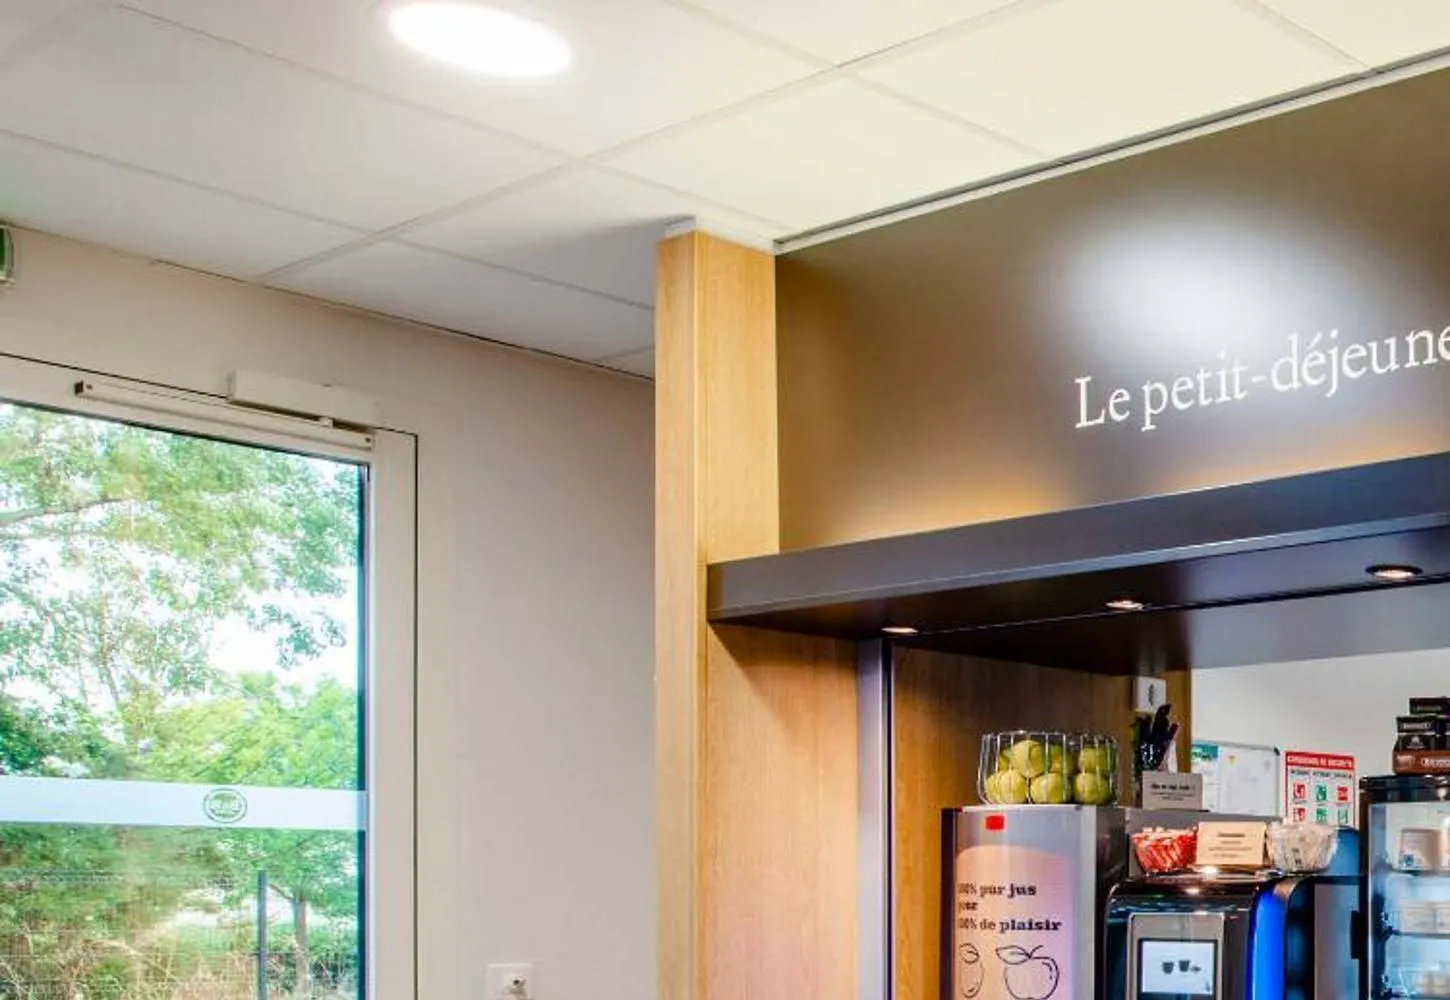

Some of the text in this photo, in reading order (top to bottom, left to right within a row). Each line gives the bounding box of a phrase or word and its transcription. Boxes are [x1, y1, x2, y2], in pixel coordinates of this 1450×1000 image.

[1074, 375, 1131, 428] Le
[1007, 882, 1038, 899] jus
[979, 918, 997, 931] de
[998, 917, 1063, 935] plaisir
